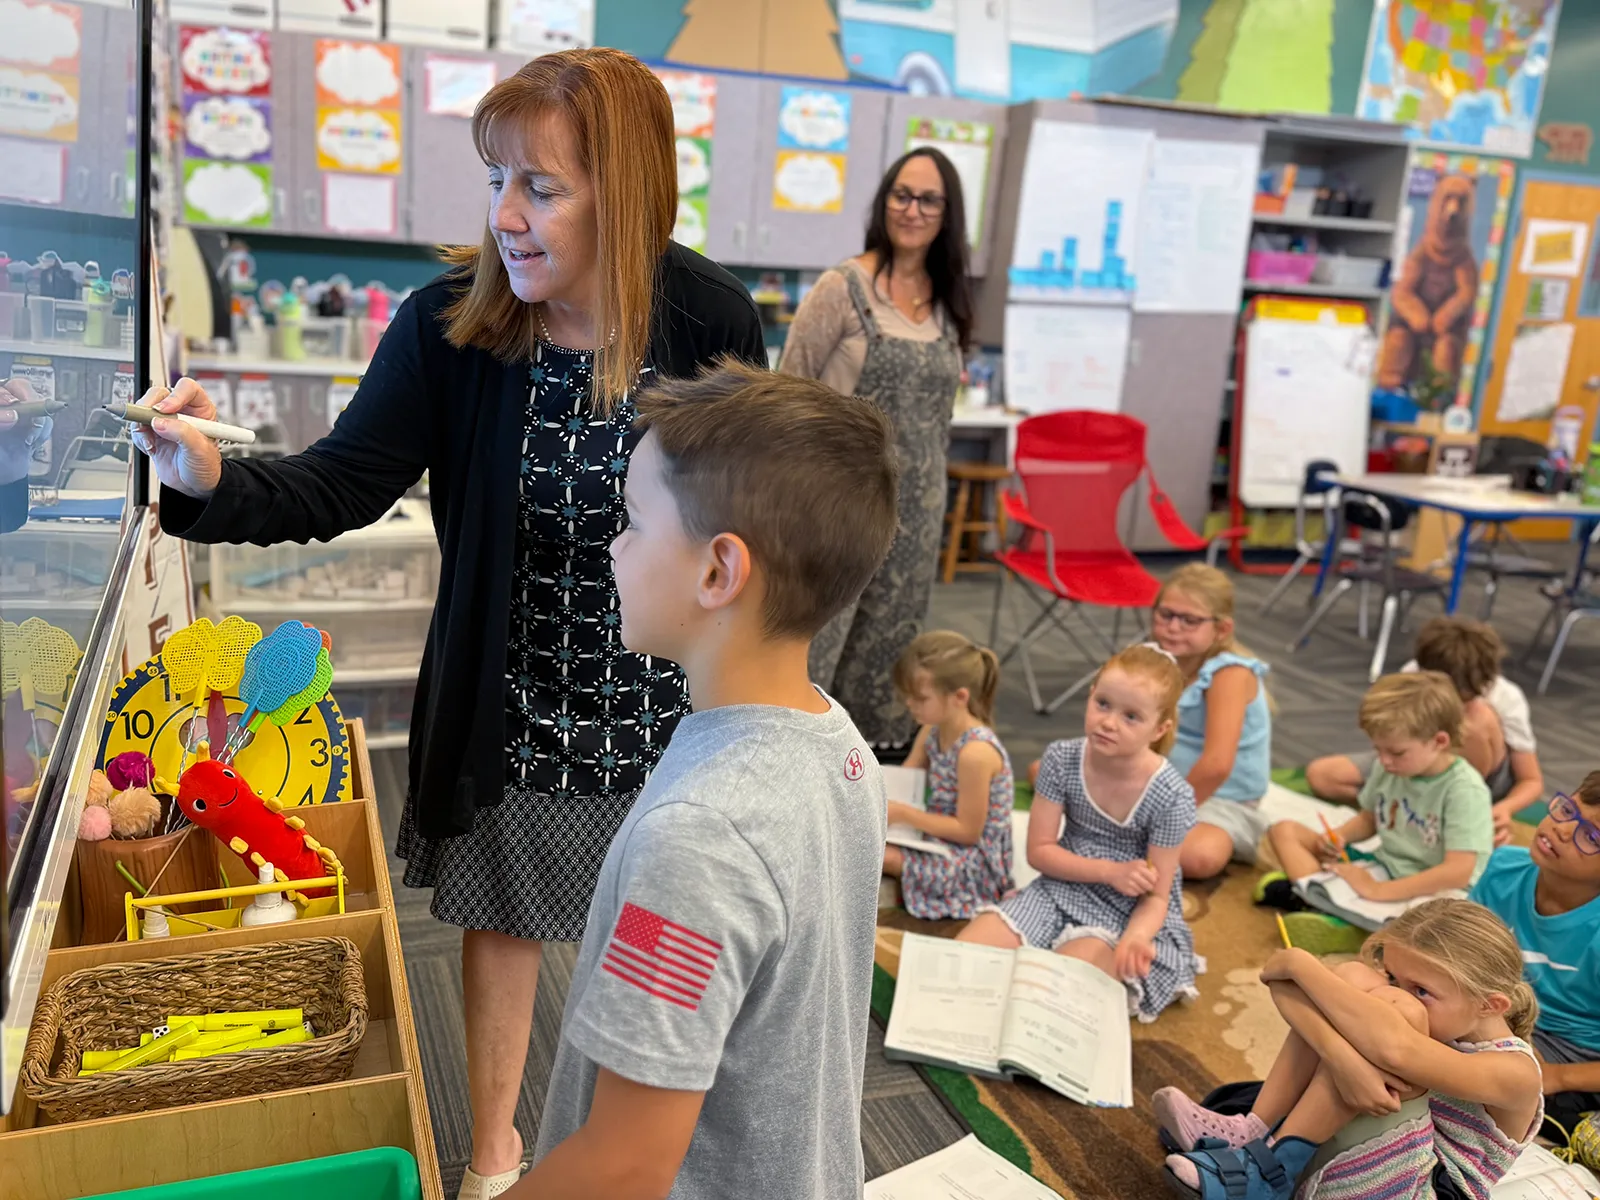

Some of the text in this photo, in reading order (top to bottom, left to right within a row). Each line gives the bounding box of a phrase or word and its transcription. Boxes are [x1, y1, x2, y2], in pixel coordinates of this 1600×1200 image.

[160, 673, 181, 702] 1
[120, 709, 154, 740] 10
[310, 738, 329, 767] 3
